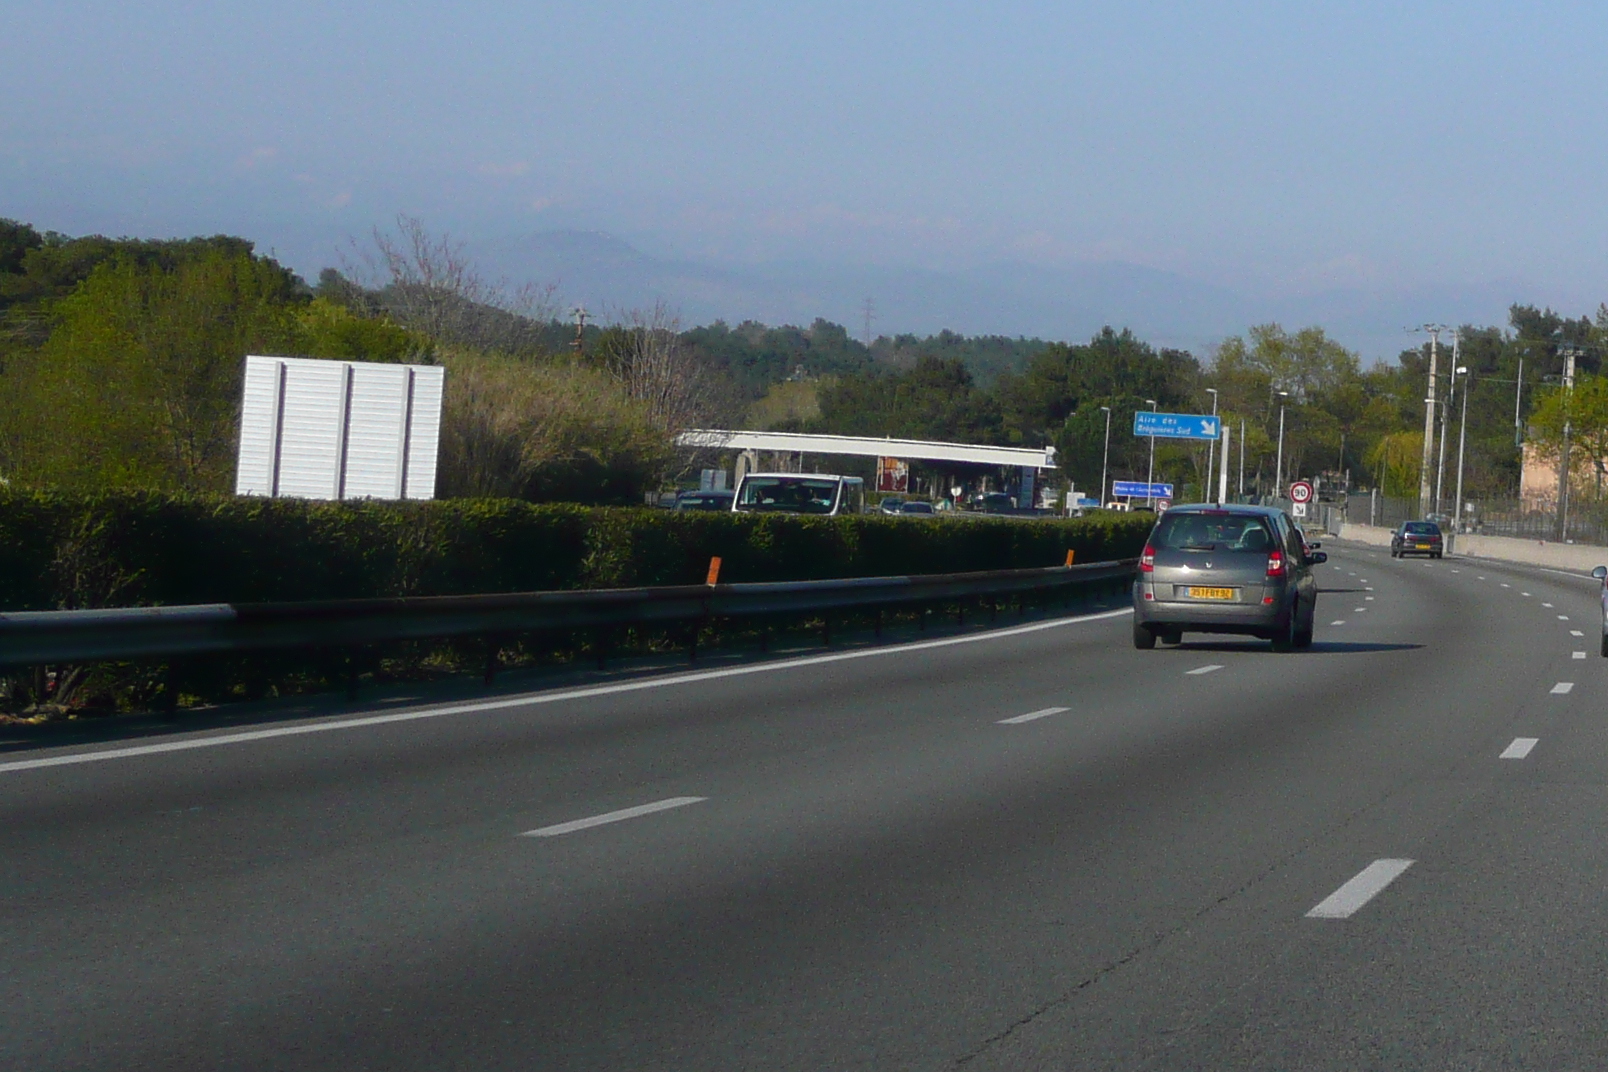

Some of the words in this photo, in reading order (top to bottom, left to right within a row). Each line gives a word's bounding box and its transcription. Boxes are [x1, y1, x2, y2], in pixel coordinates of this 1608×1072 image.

[1138, 415, 1156, 423] Aire
[1162, 416, 1177, 425] des
[1295, 488, 1306, 497] 90
